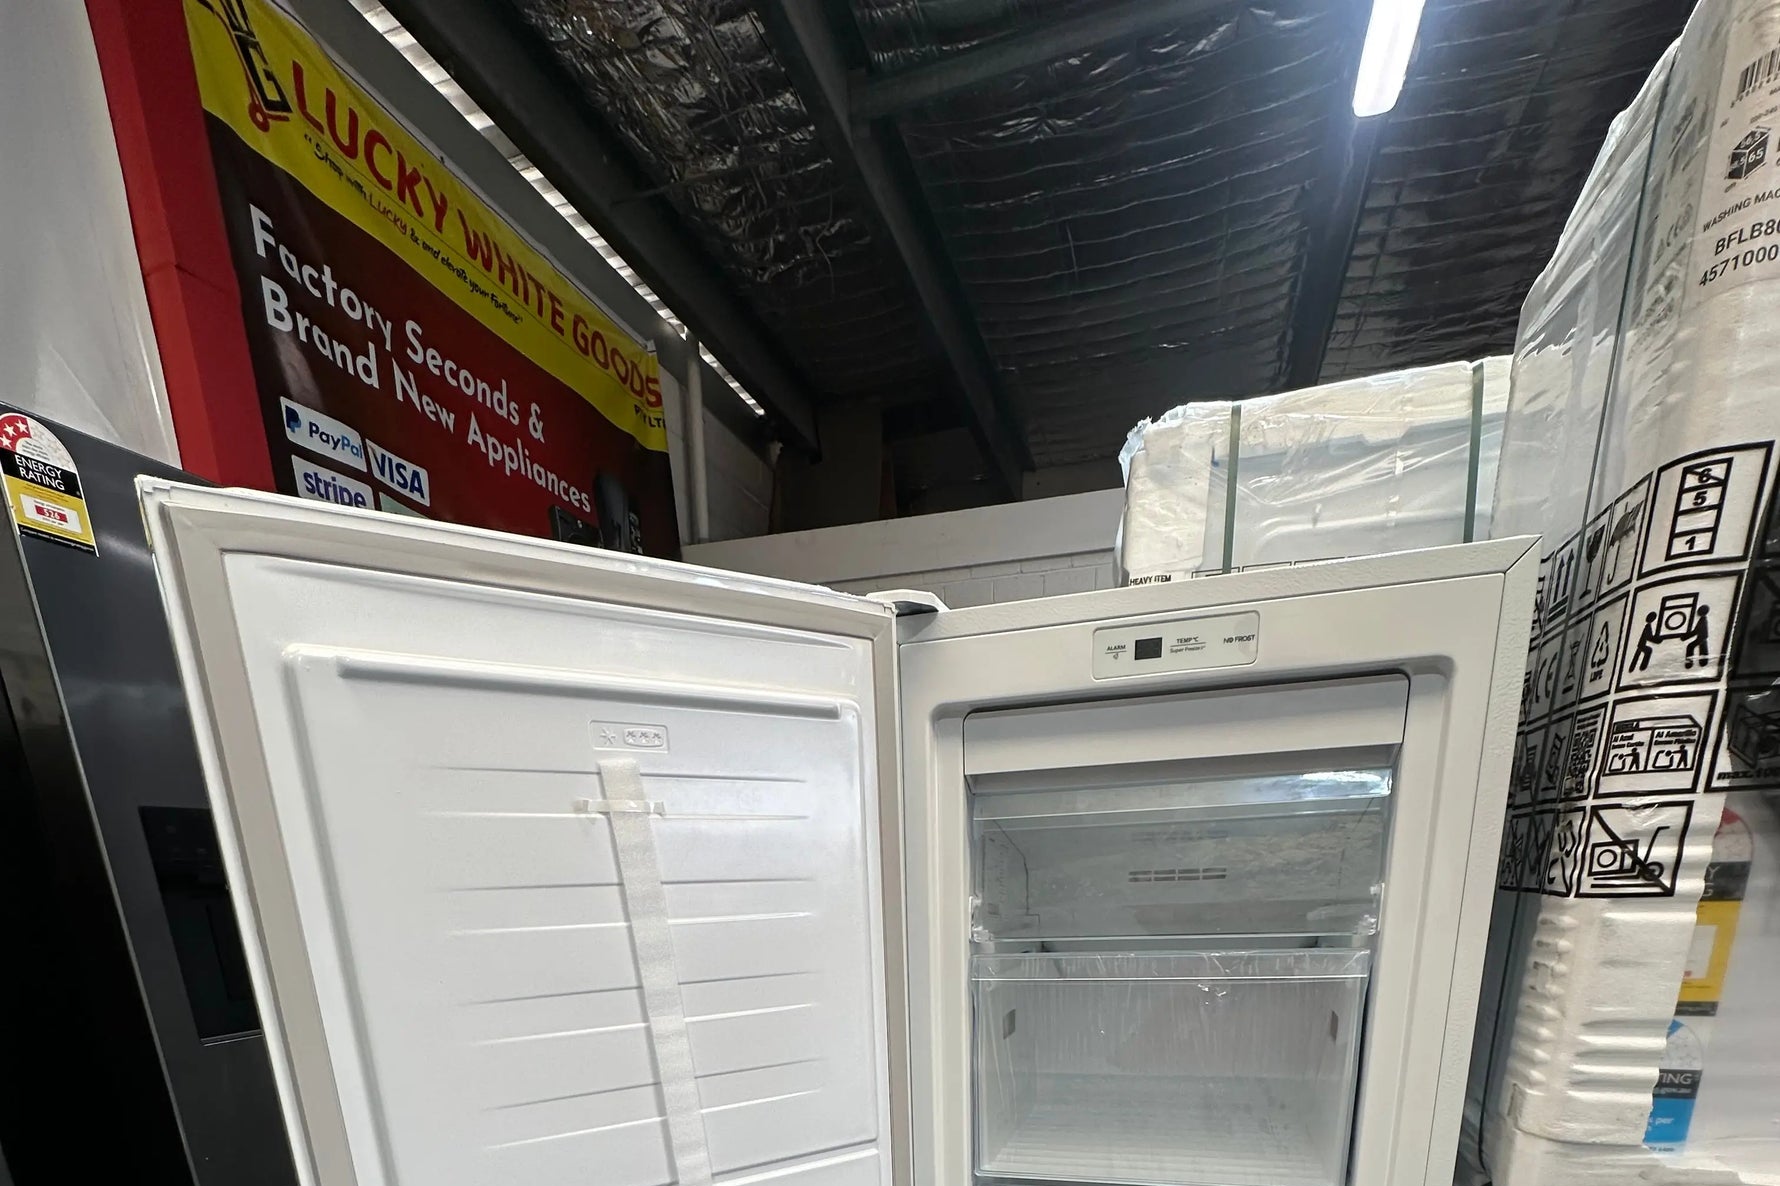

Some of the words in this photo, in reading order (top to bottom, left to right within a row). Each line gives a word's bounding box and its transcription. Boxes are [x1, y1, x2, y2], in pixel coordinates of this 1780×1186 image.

[292, 59, 448, 234] LUCKY
[457, 208, 565, 337] WHITE
[572, 313, 663, 408] GOODS
[1702, 197, 1752, 233] WASHING
[250, 203, 392, 352] Factory
[405, 319, 519, 425] Seconds
[528, 402, 545, 443] &
[261, 275, 380, 390] Brand
[392, 357, 455, 434] New
[467, 411, 591, 513] Appliances
[308, 421, 363, 459] PayPal
[14, 454, 62, 480] ENERGY
[18, 466, 65, 491] RATING
[367, 444, 425, 499] VISA
[303, 471, 367, 509] stripe
[1129, 575, 1153, 586] HEAVY
[1154, 574, 1172, 583] ITEM
[1106, 644, 1127, 652] ALARM
[1234, 633, 1256, 644] FROST
